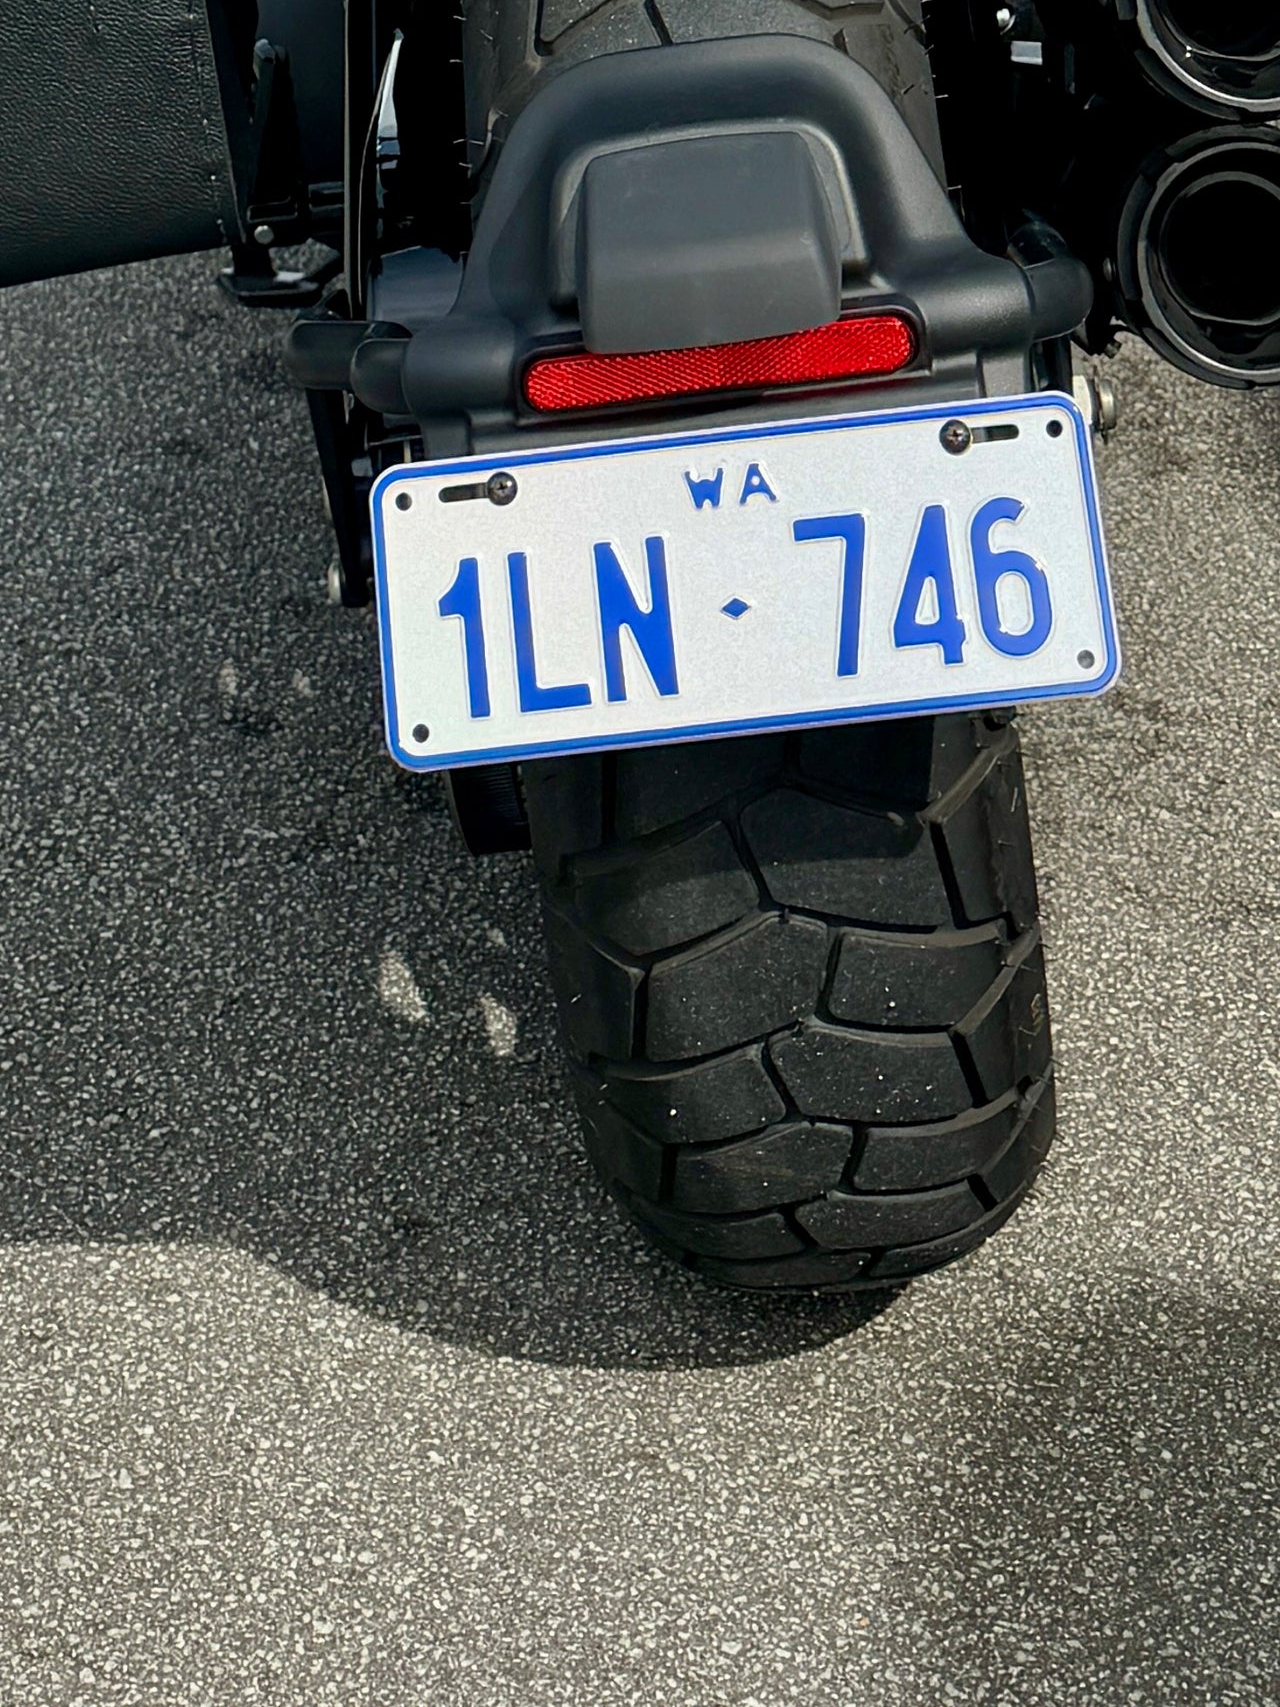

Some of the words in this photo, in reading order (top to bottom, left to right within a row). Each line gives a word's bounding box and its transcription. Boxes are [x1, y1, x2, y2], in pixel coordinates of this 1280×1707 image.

[682, 461, 778, 510] WA
[436, 534, 681, 719] 1LN
[792, 496, 1053, 678] 746
